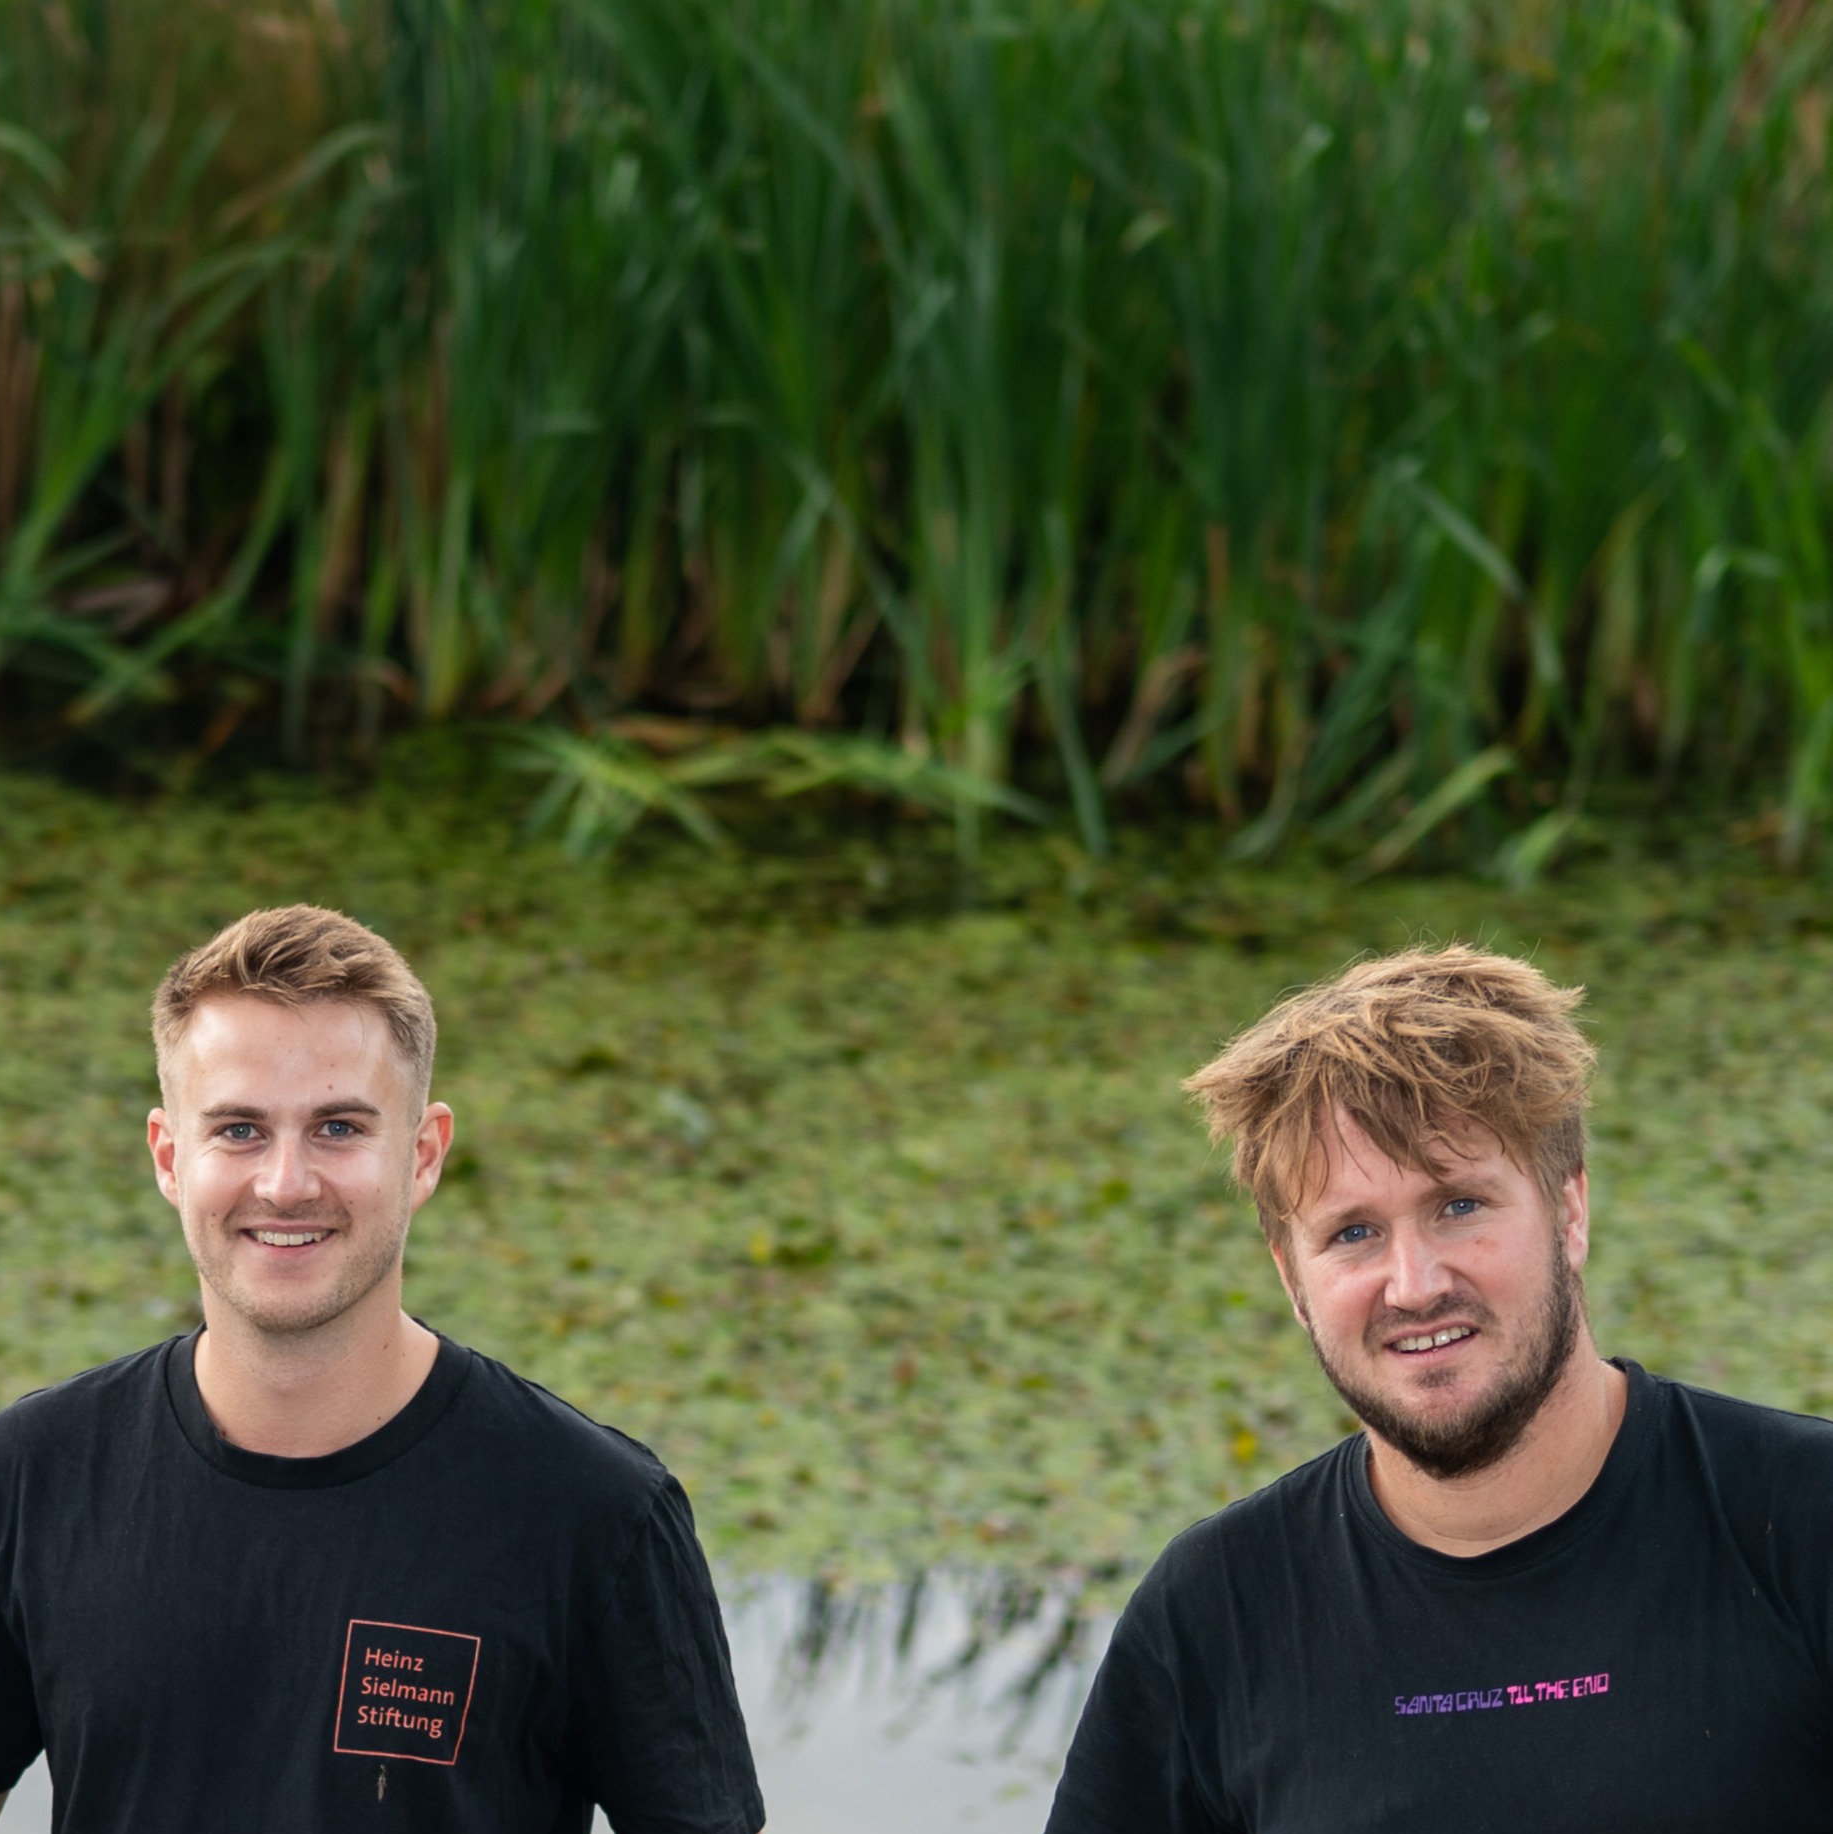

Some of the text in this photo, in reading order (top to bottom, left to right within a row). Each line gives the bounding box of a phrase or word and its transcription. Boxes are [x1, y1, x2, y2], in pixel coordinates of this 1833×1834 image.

[365, 1647, 424, 1672] Heinz
[361, 1676, 456, 1706] Sielmann
[1394, 1672, 1610, 1715] SANTA CRUZ TIL THE END
[357, 1705, 443, 1739] Stiftung
